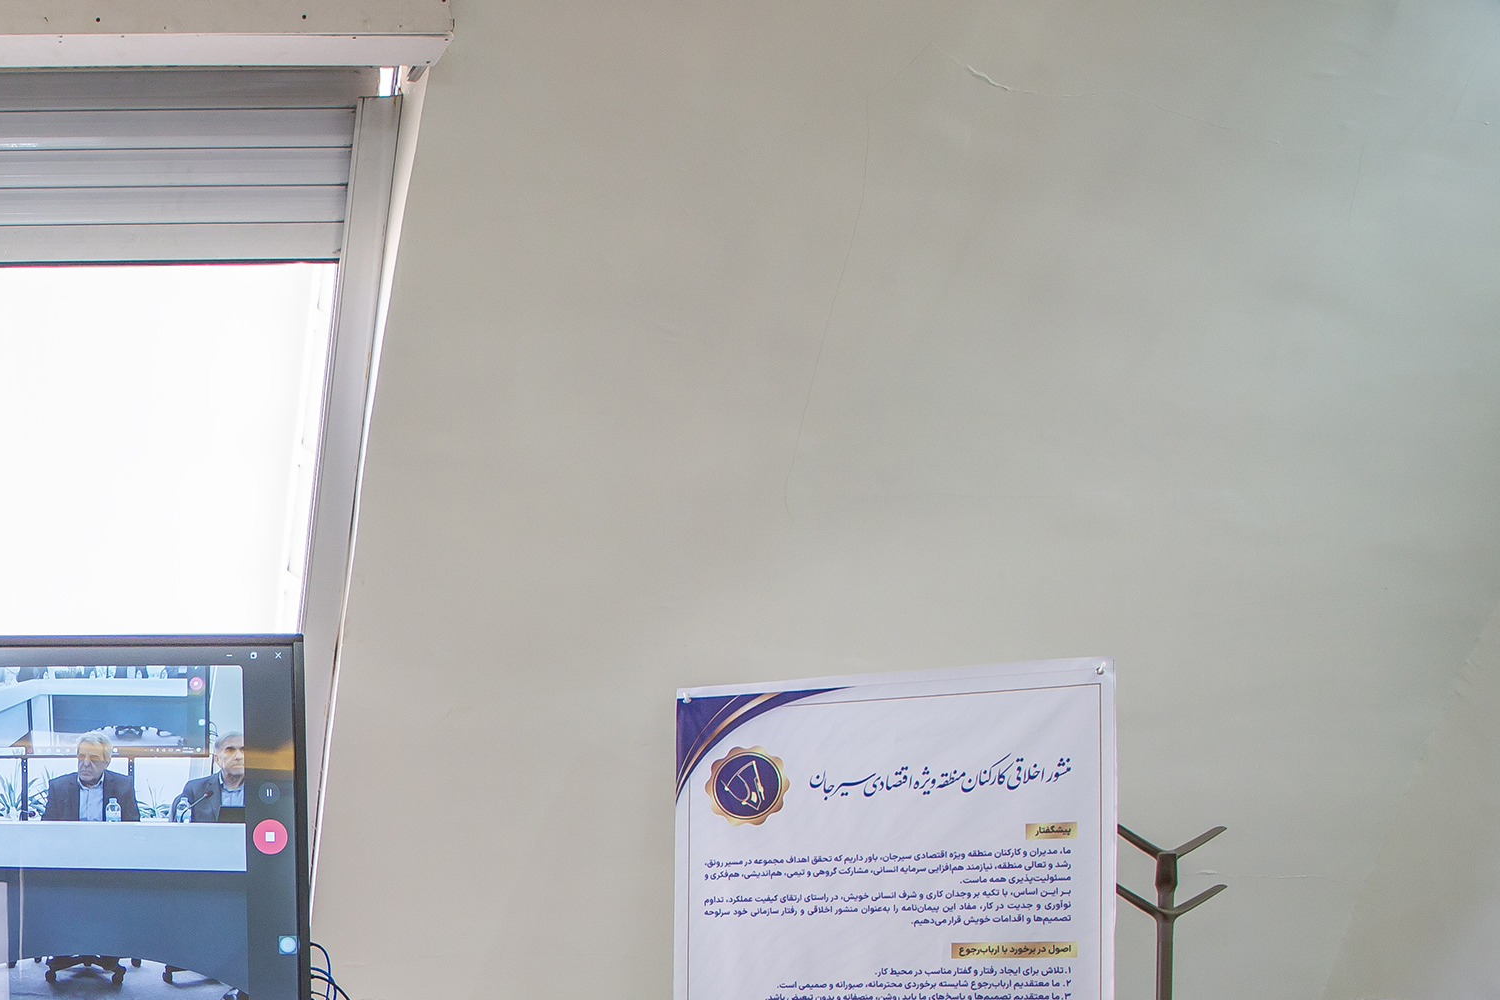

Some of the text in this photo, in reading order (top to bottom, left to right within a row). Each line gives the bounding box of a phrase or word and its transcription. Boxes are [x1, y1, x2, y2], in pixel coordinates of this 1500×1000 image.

[809, 753, 1072, 801] منشور اخلاقی کارکنان منطقه ویژه اقتصادی سیرجان
[1035, 826, 1071, 836] پیشگفتار
[834, 854, 843, 862] که
[914, 850, 948, 862] اقتصادی
[949, 852, 966, 861] ویژه
[968, 850, 993, 858] منطقه
[994, 848, 1021, 859] کارکنان
[1022, 850, 1028, 858] و
[1029, 848, 1058, 858] مدیران
[724, 860, 743, 868] مسیر
[754, 859, 784, 867] مجموعه
[786, 856, 810, 864] اهداف
[811, 856, 832, 866] تحقق
[844, 854, 864, 865] داریم
[864, 854, 878, 864] باور
[804, 893, 829, 903] راستای
[871, 892, 896, 902] انسانی
[898, 890, 917, 901] شرف
[926, 890, 944, 900] کاری
[945, 890, 972, 900] وجدان
[982, 888, 1000, 899] تکیه
[1002, 888, 1008, 898] با
[704, 896, 724, 907] تداوم
[754, 894, 778, 904] کیفیت
[780, 894, 802, 904] ارتقای
[830, 895, 839, 903] در
[948, 915, 962, 926] قرار
[963, 916, 991, 926] خویش
[992, 914, 1024, 923] اقدامات
[1026, 917, 1031, 925] و
[1002, 946, 1008, 955] با
[1010, 946, 1036, 956] برخورد
[1038, 946, 1046, 955] در
[1048, 945, 1071, 955] اصول
[890, 968, 913, 978] محیط
[914, 969, 923, 978] در
[924, 967, 952, 977] مناسب
[952, 966, 972, 977] گفتار
[973, 969, 978, 977] و
[979, 966, 998, 977] رفتار
[999, 966, 1021, 977] ایجاد
[1022, 966, 1039, 977] برای
[1041, 966, 1064, 977] تلاش
[798, 983, 827, 991] صمیمی
[835, 981, 864, 991] صبورانه
[904, 980, 937, 990] برخوردی
[938, 980, 969, 990] شایسته
[1013, 980, 1050, 991] معتقدیم
[1051, 979, 1060, 987] ما
[843, 993, 874, 1000] منصفانه
[918, 993, 927, 1000] ما
[1051, 992, 1060, 1000] ما
